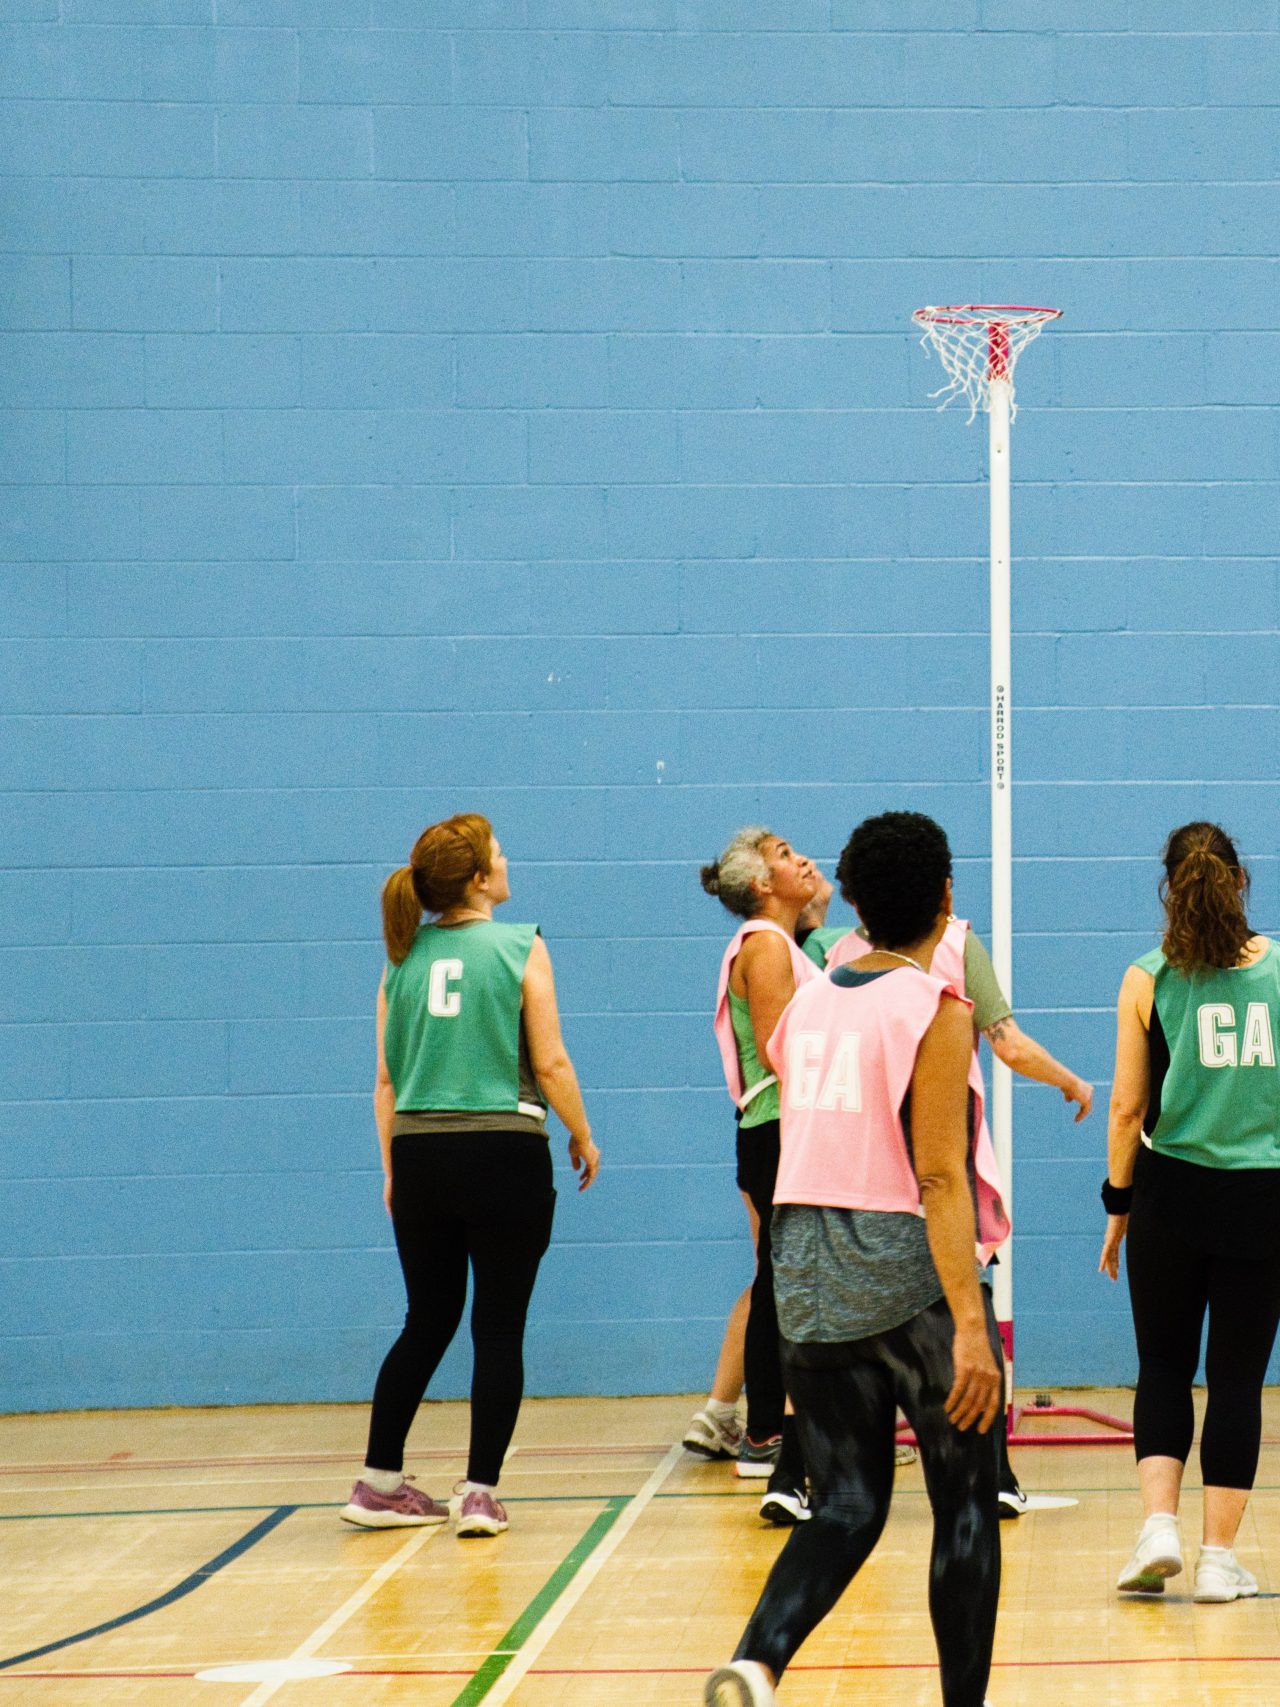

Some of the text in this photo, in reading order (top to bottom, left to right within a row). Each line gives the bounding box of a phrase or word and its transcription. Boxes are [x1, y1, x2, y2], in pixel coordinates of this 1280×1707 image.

[996, 695, 1005, 740] HARROD
[428, 958, 464, 1017] C
[1197, 1002, 1276, 1069] GA
[789, 1031, 862, 1113] GA
